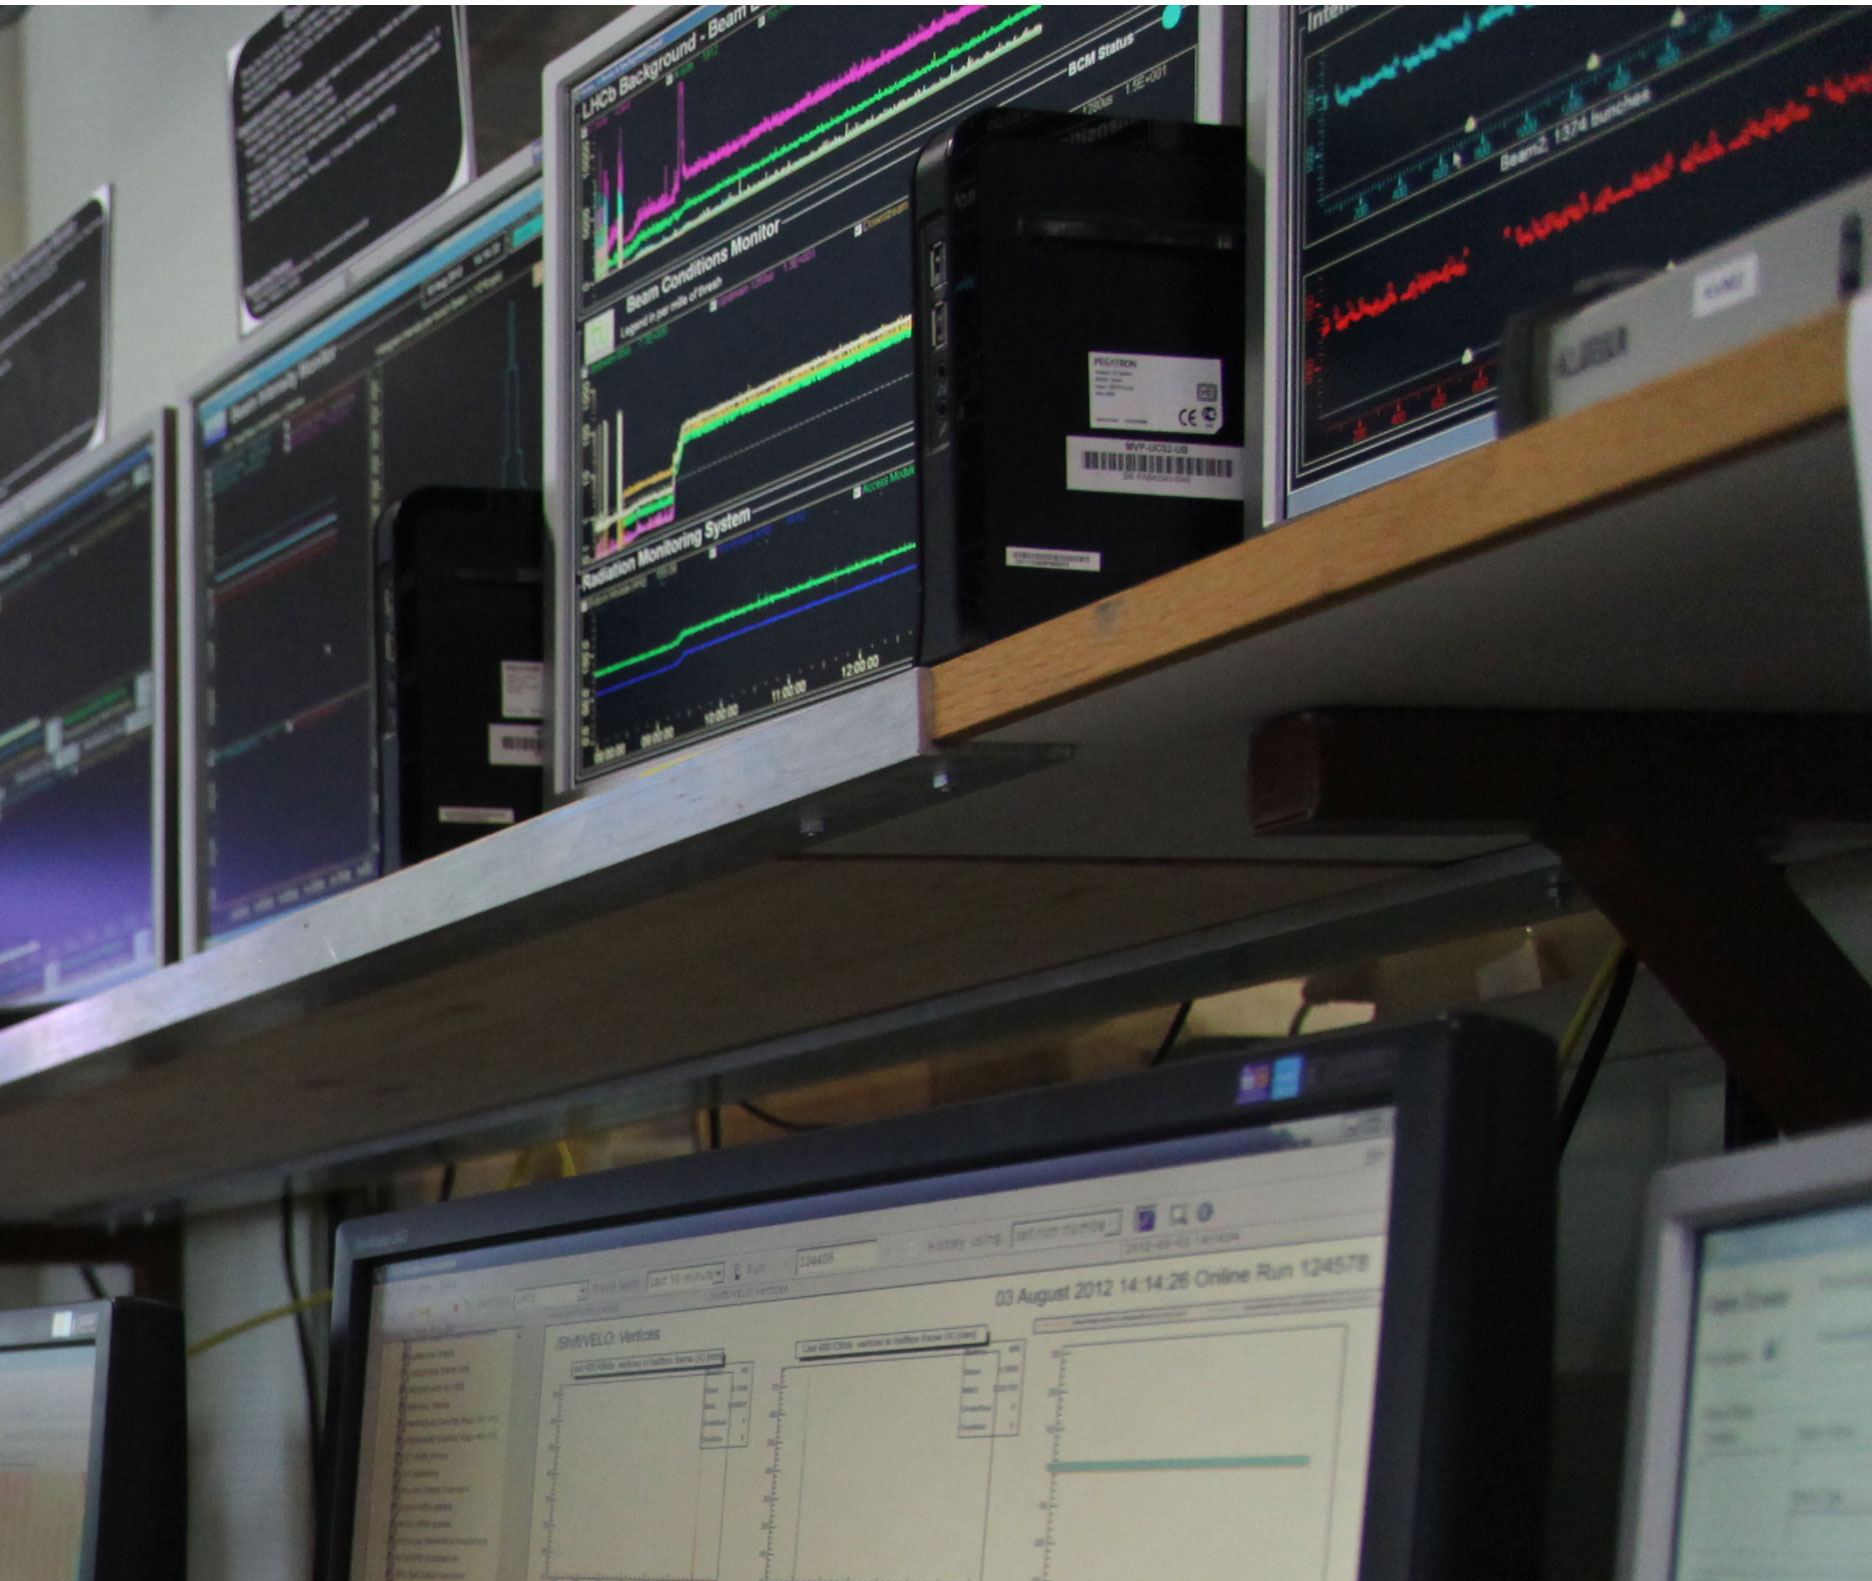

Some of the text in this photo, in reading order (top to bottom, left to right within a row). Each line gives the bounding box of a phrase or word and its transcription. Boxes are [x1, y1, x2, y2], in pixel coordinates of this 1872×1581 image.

[581, 84, 617, 121] LHCb
[618, 34, 697, 97] Background
[708, 6, 747, 40] Beam
[1068, 31, 1135, 77] BCM Status
[626, 218, 782, 313] Beam Conditions Monitor
[582, 557, 636, 591] Radiation
[638, 529, 702, 567] Monitoring
[705, 508, 751, 539] System
[771, 680, 807, 702] 11:00:00
[842, 655, 879, 678] 12:00:00
[996, 1290, 1014, 1306] 03
[1018, 1284, 1071, 1307] August
[1074, 1280, 1113, 1300] 2012
[1194, 1268, 1251, 1288] Online
[1257, 1264, 1293, 1281] Run
[619, 1328, 661, 1345] Vertices
